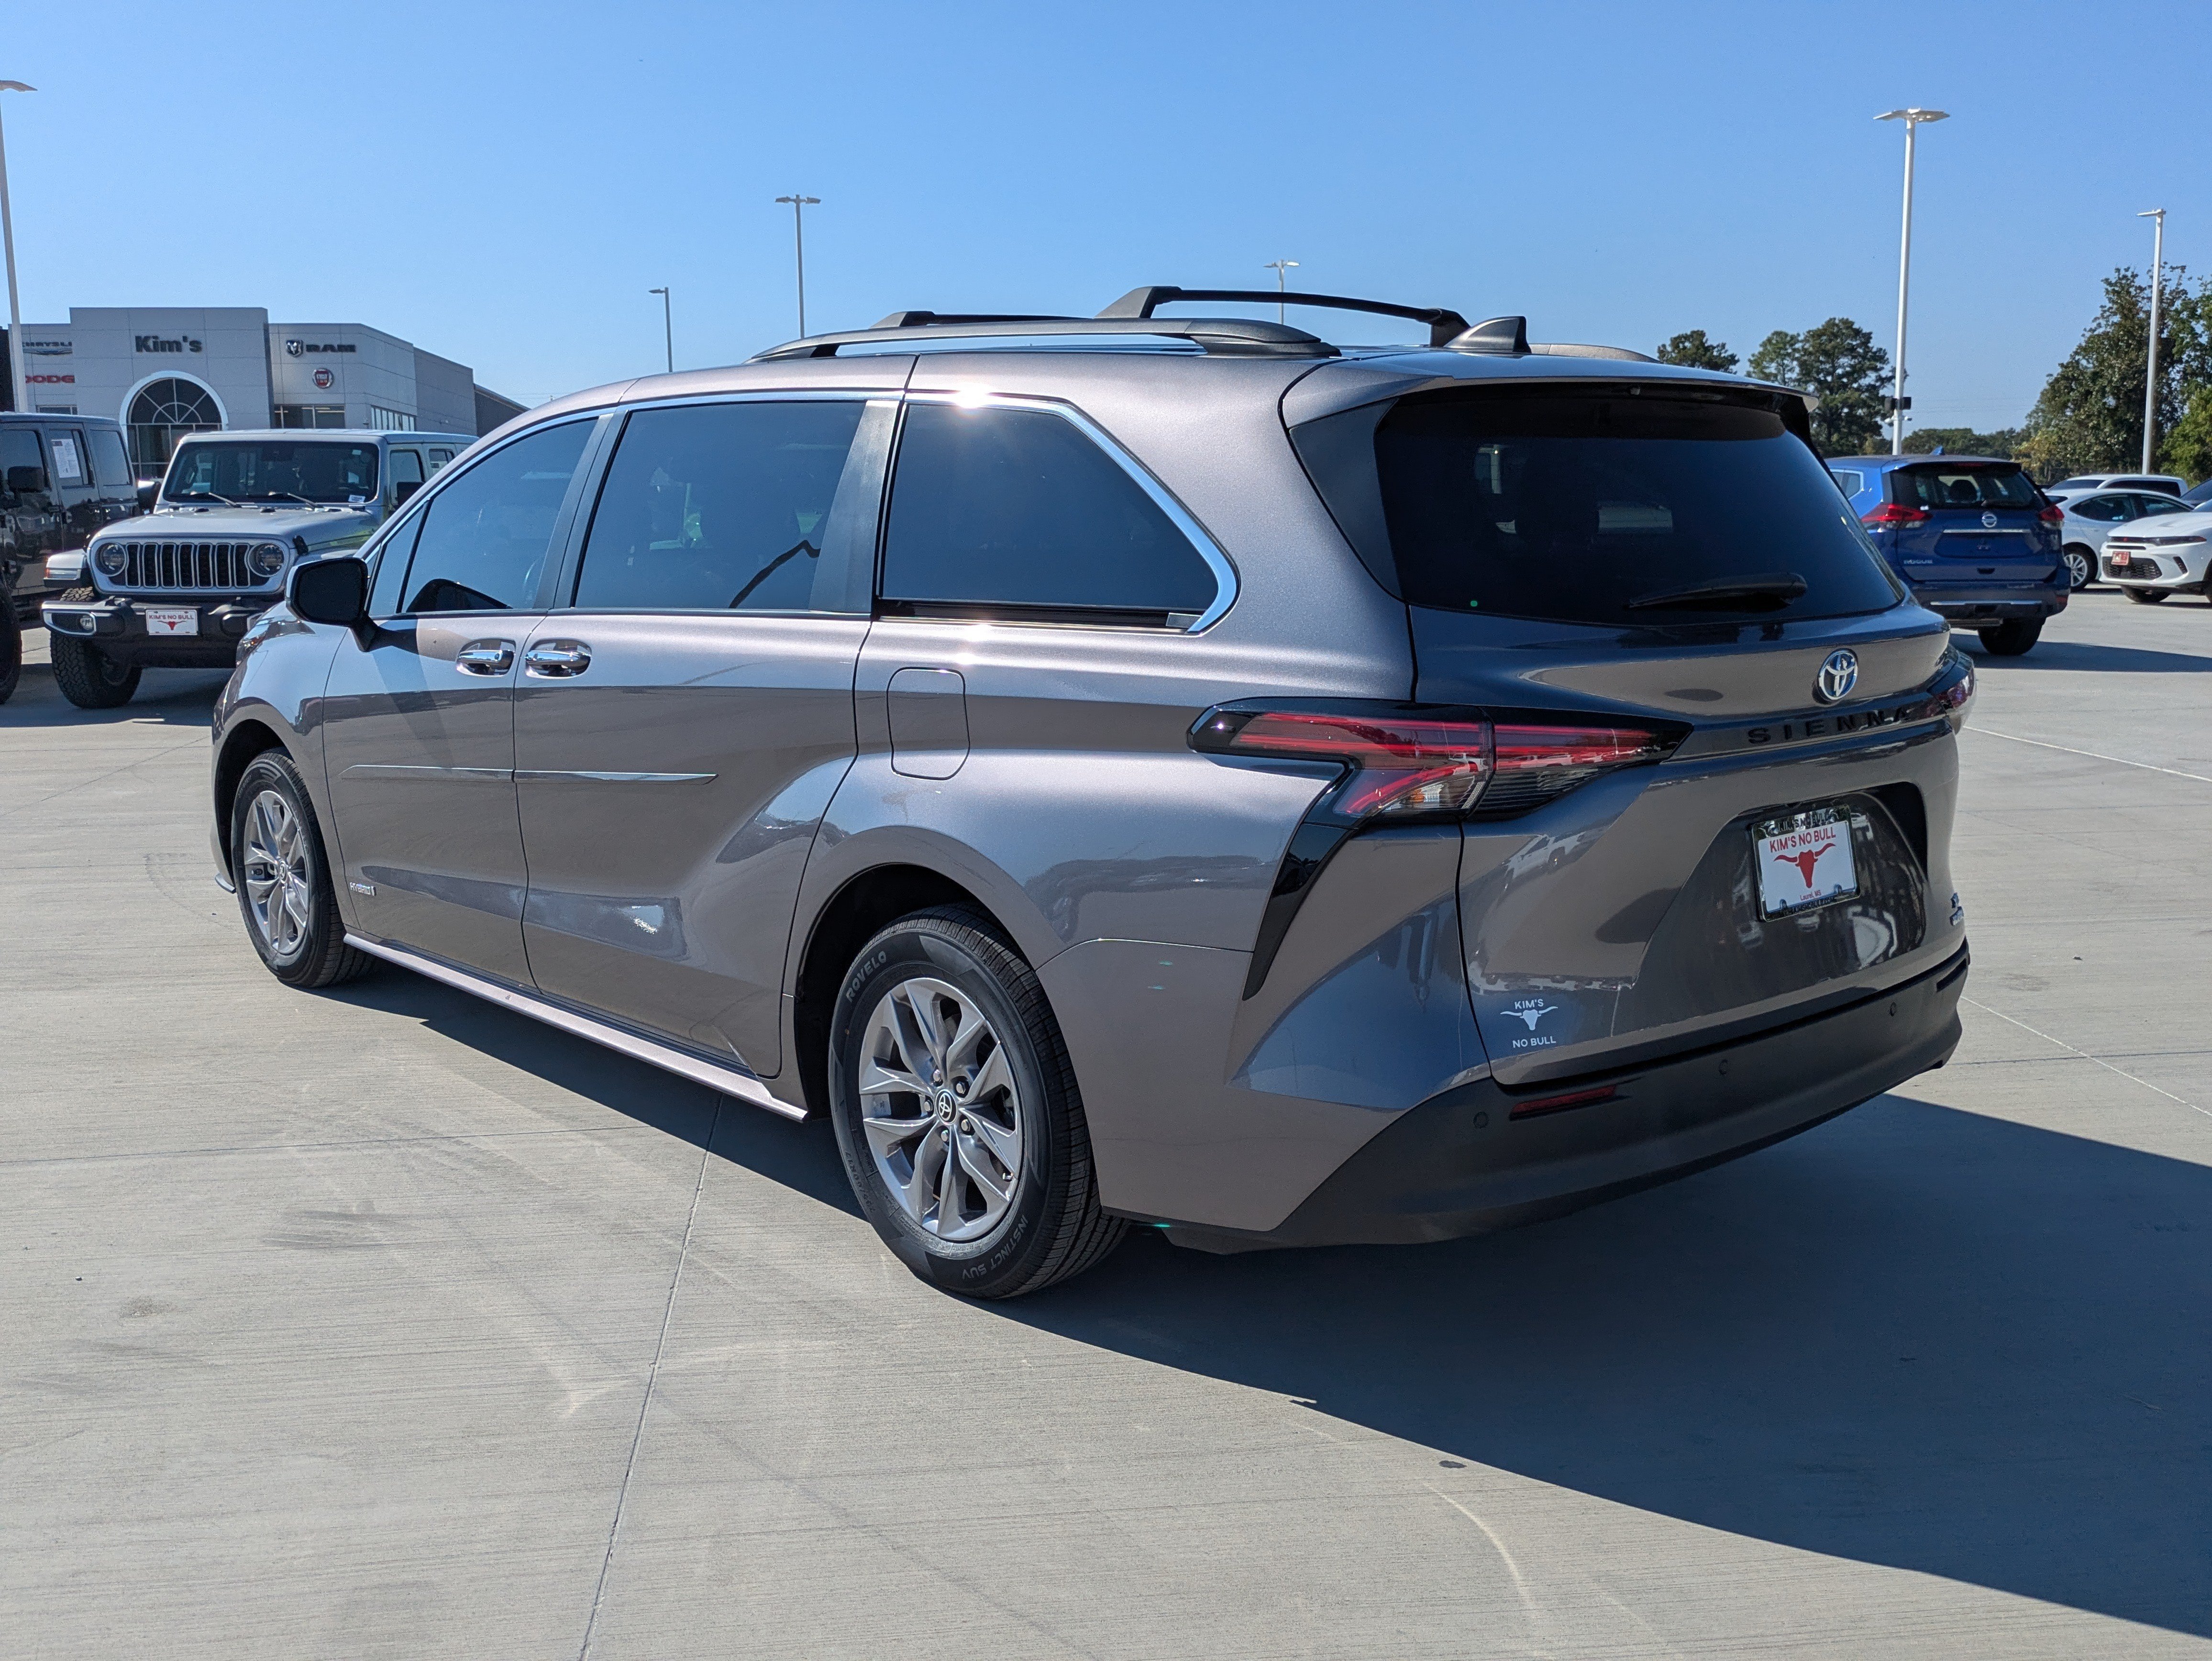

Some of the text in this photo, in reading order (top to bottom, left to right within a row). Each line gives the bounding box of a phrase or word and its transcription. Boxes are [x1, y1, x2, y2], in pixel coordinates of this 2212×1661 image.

[135, 335, 202, 353] Kim's
[306, 344, 356, 352] RAM
[1747, 708, 1909, 744] SIENNA
[1769, 827, 1836, 853] KIM'S NO BULL
[846, 951, 887, 1002] ROVELO
[1514, 998, 1544, 1009] KIM'S
[1512, 1036, 1557, 1048] NO BULL
[990, 1214, 1029, 1271] INSTINCT
[962, 1263, 987, 1280] SUV
